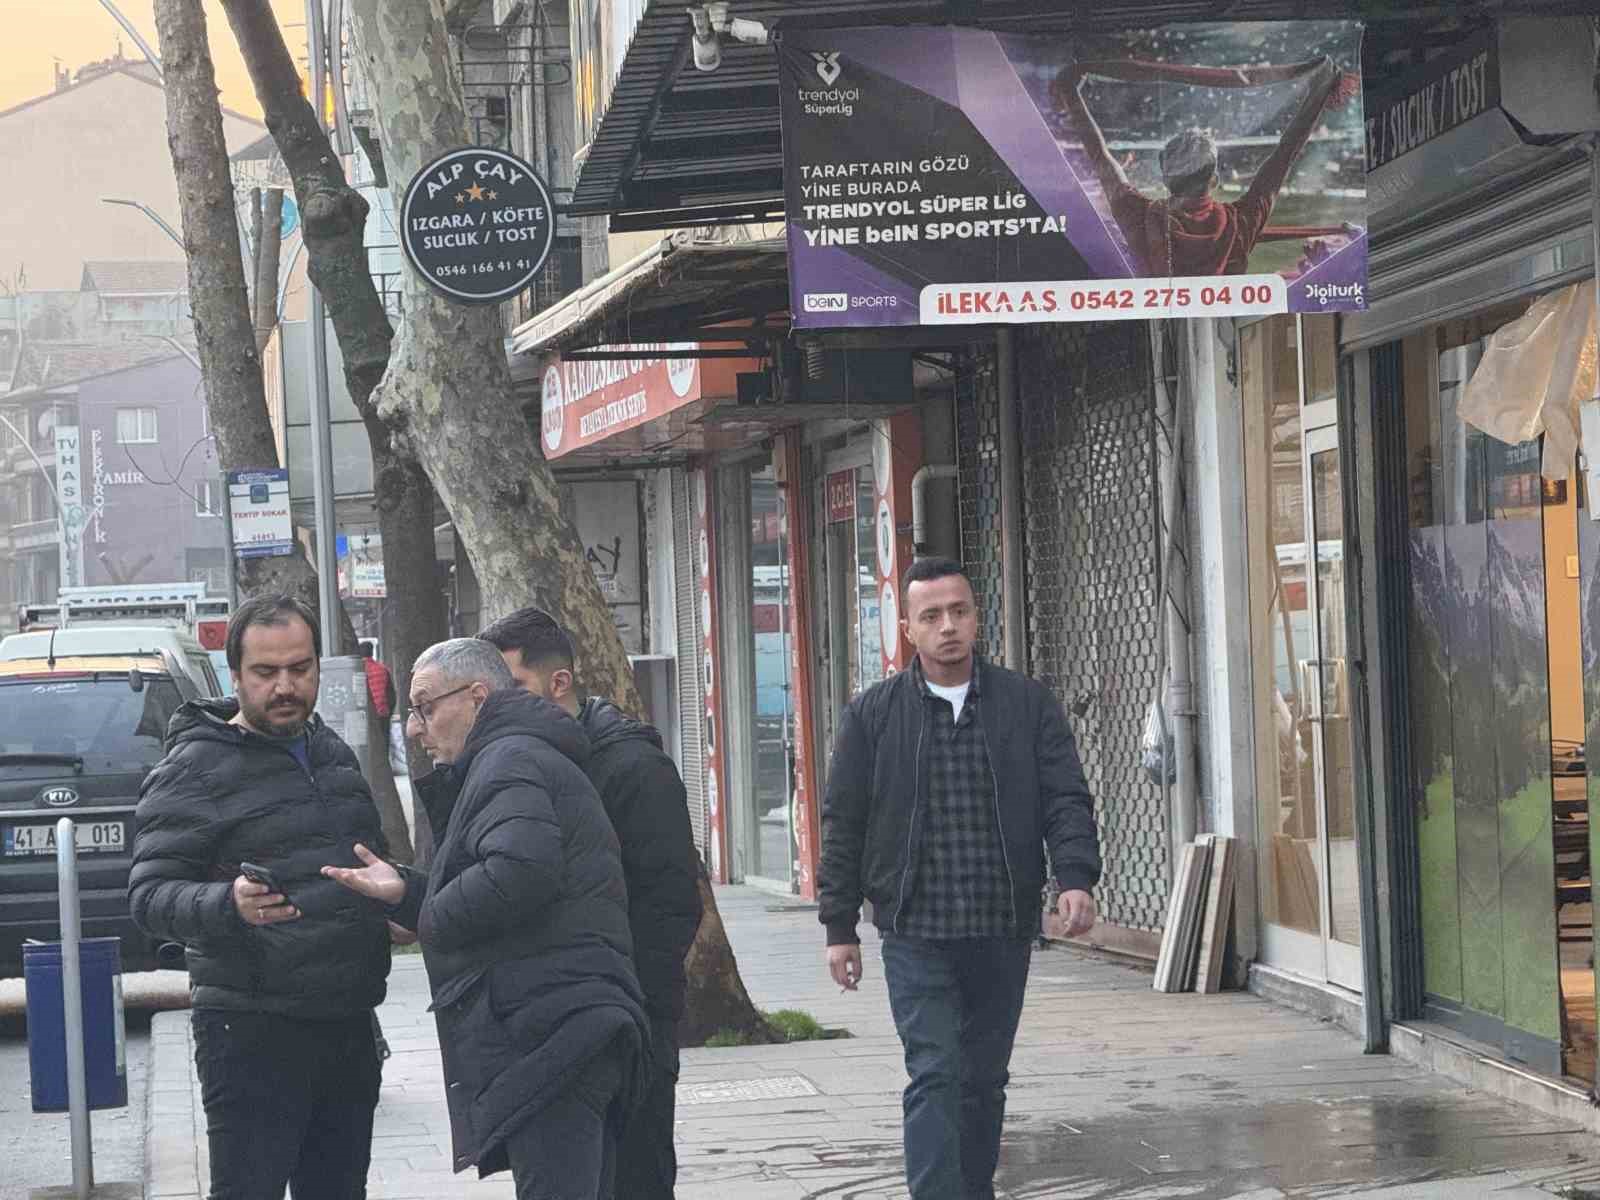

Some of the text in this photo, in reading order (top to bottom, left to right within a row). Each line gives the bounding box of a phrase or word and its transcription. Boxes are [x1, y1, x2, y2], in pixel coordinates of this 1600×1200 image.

[799, 87, 859, 102] trendyol
[1391, 82, 1436, 159] SUCUK
[1451, 52, 1488, 125] TOST
[801, 155, 970, 179] TARAFTARIN GÖZÜ
[425, 160, 523, 200] ALP ÇAY
[801, 179, 922, 198] YİNE BURADA
[803, 190, 1027, 220] TRENDYOL SÜPER LİG
[412, 206, 544, 231] IZGARA / KÖFTE
[423, 226, 537, 249] SUCUK / TOST
[804, 226, 860, 247] YİNE
[436, 258, 530, 277] 0546 166 41 41
[851, 295, 897, 308] SPORTS
[1070, 289, 1134, 310] 0542
[1143, 287, 1191, 308] 275
[1200, 286, 1232, 306] 04
[1241, 285, 1273, 304] 00
[1305, 282, 1364, 304] Digiturk
[57, 439, 77, 449] TV
[15, 828, 33, 848] 41
[92, 823, 121, 844] 013
